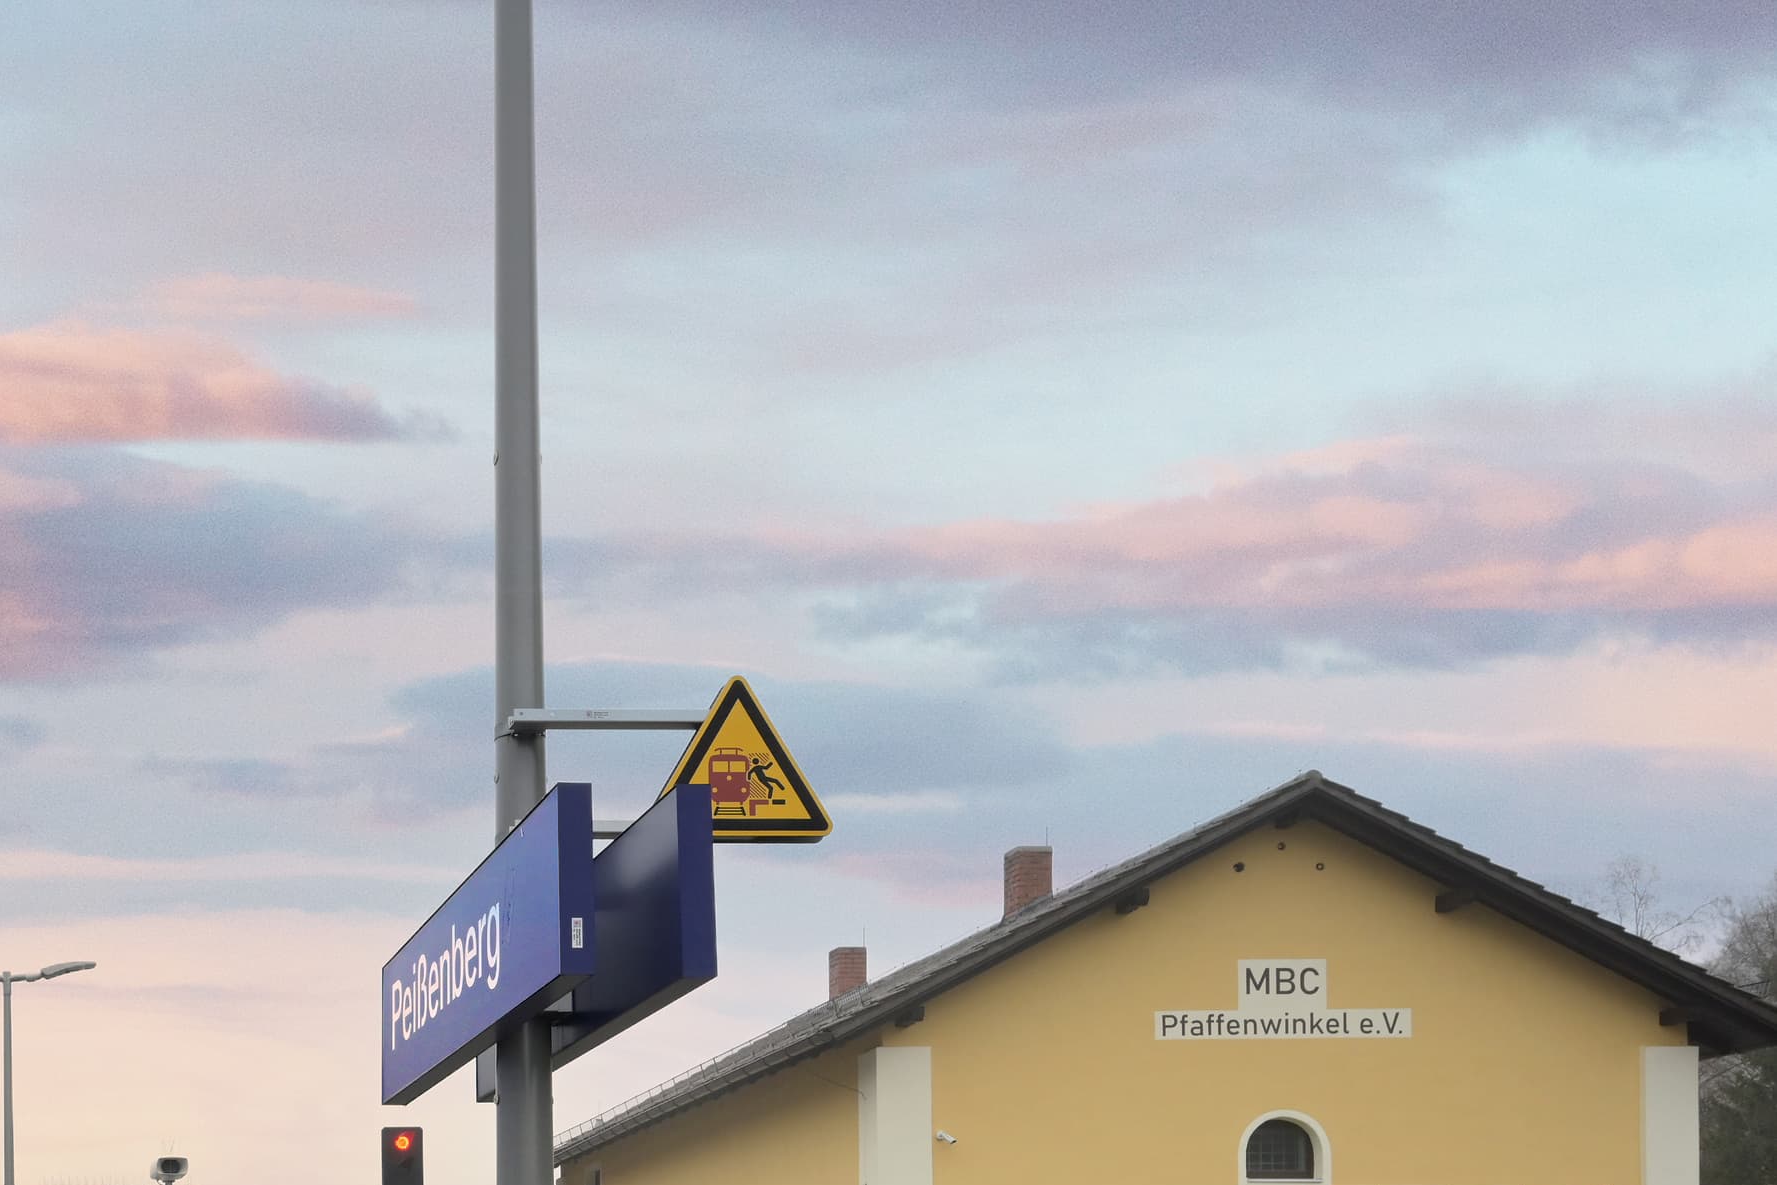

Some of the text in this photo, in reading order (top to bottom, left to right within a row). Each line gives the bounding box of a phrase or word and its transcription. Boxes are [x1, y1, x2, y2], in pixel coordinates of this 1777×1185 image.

[391, 902, 500, 1051] Peißenberg
[1245, 966, 1320, 995] MBC
[1161, 1012, 1403, 1036] Pfaffenwinkel e.V.
